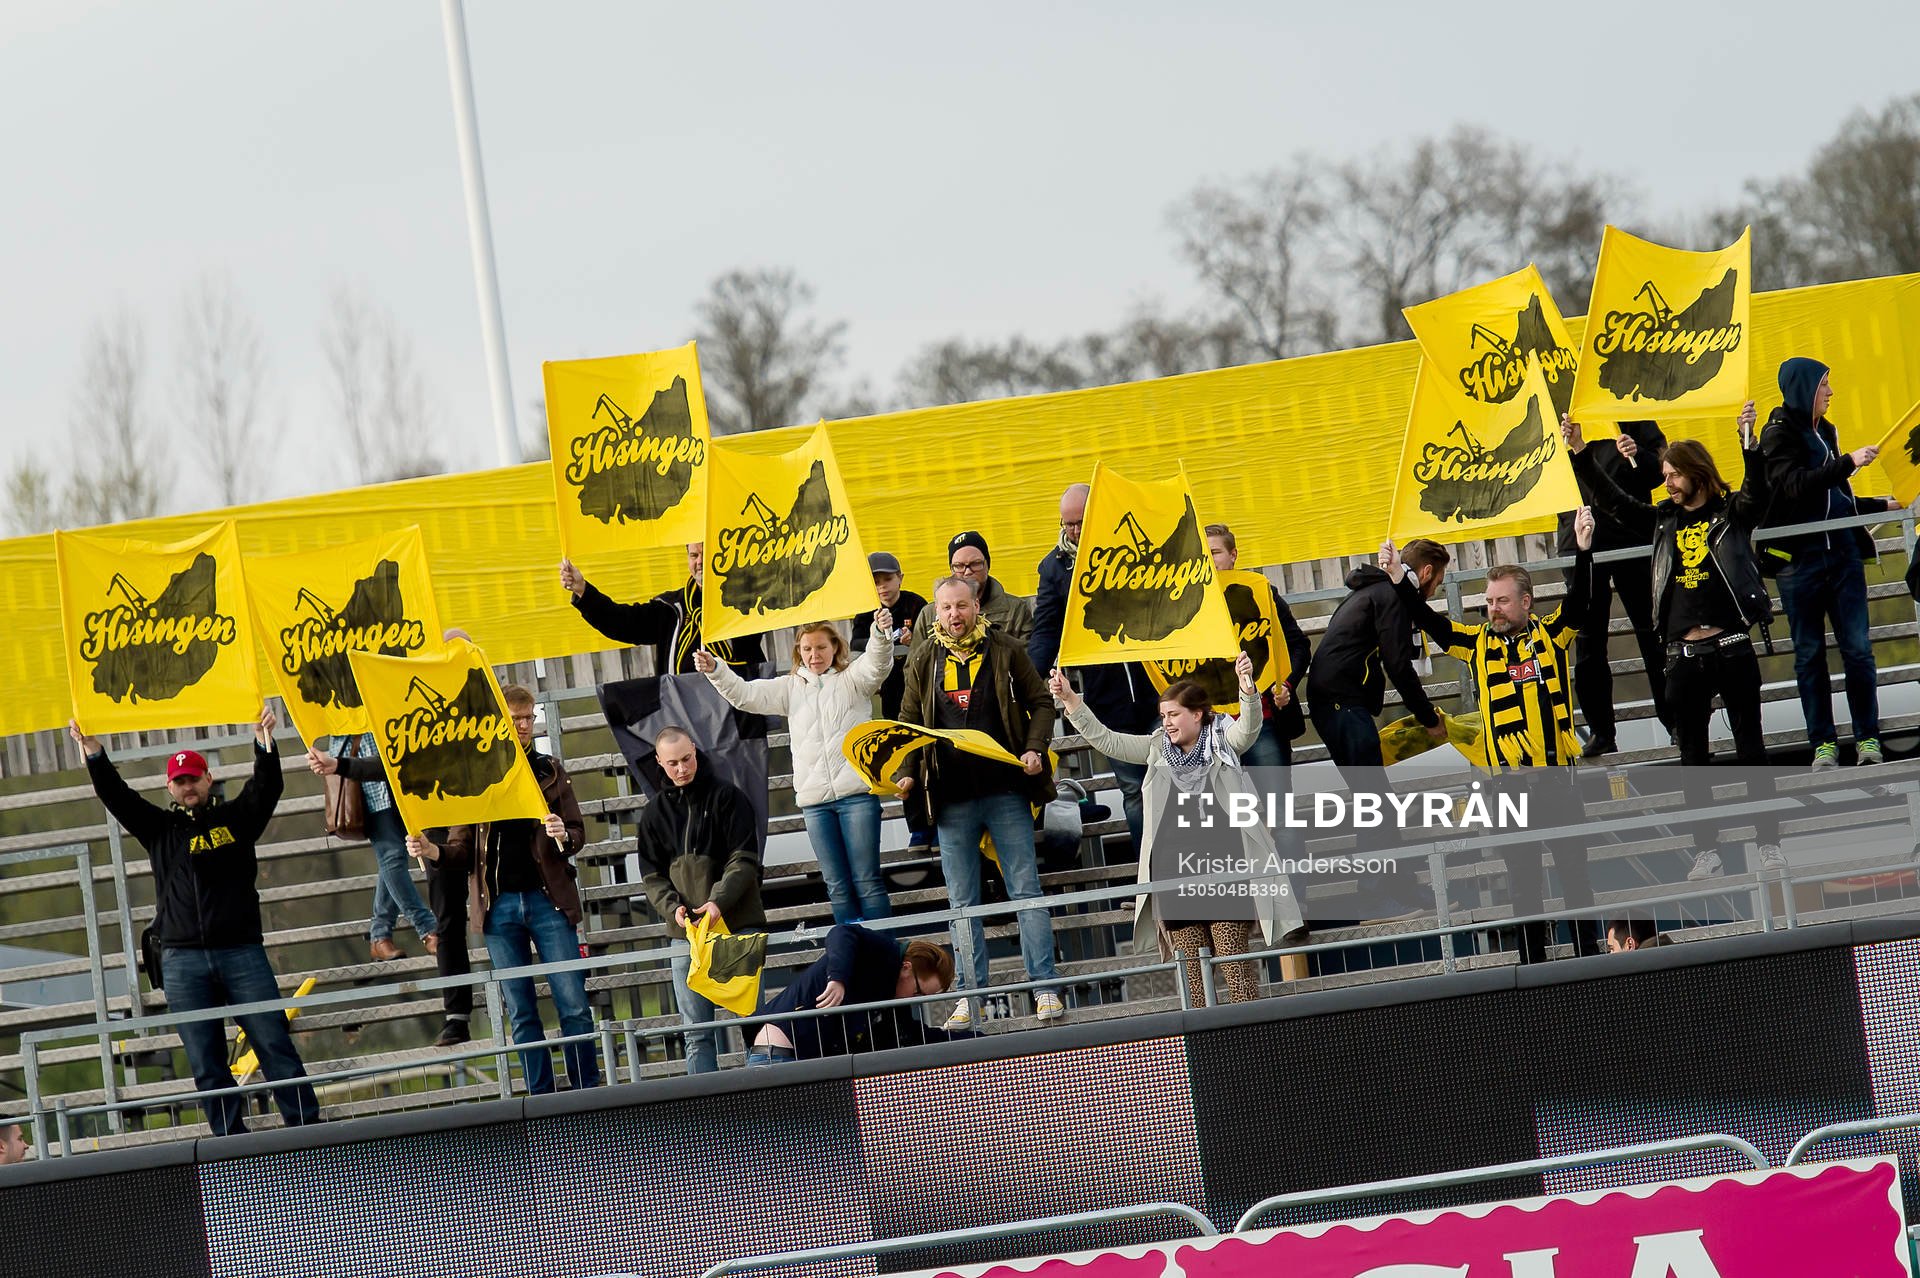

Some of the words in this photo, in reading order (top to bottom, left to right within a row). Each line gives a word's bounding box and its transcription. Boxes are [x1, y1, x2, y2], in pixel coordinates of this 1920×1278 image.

[1594, 313, 1741, 363] Hisingen
[1460, 347, 1577, 401] Hisigen
[566, 428, 703, 485] Hisingen
[1413, 433, 1555, 485] Hisingen
[713, 512, 849, 575] Hisingen
[1079, 545, 1212, 601] Hisingen
[82, 606, 235, 662] Hisingen
[281, 617, 425, 676] Hisingen
[386, 707, 515, 766] Hisinge
